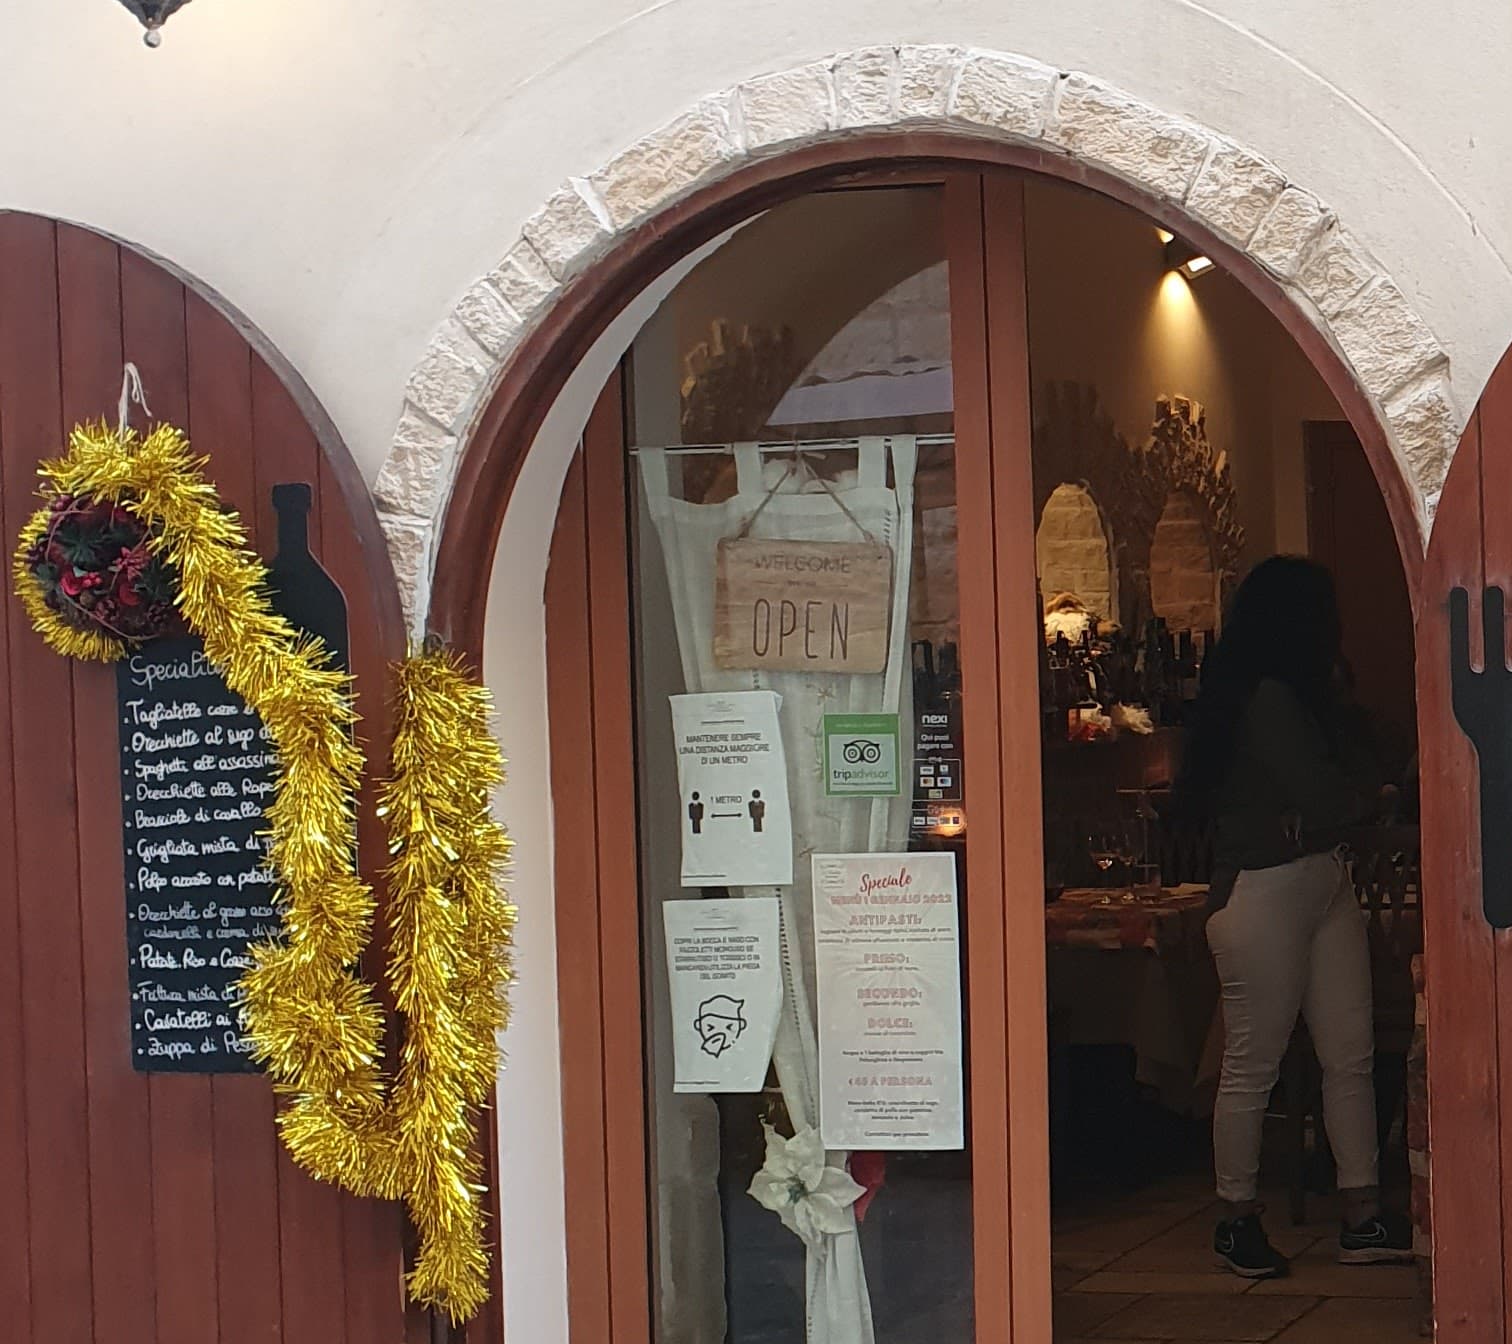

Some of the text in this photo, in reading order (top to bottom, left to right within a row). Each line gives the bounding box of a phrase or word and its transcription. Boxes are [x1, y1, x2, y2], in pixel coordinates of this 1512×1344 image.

[754, 555, 851, 574] WELCOME
[752, 598, 849, 661] OPEN
[126, 699, 201, 729] Tagliatelle
[922, 715, 948, 723] nexi
[132, 729, 199, 752] Orecchiette
[205, 726, 223, 745] al
[228, 727, 254, 750] sugo
[135, 757, 189, 781] Spaghetti
[722, 756, 748, 764] METRO
[137, 782, 206, 801] Orecchiette
[210, 782, 237, 797] alle
[716, 796, 742, 804] METRO
[195, 807, 210, 822] di
[137, 839, 198, 863] Grigliata
[202, 836, 240, 855] mista
[246, 834, 261, 850] di
[138, 867, 167, 892] Polpo
[860, 868, 912, 896] Speciale
[203, 902, 217, 919] al
[188, 985, 220, 1001] mista
[216, 1013, 231, 1026] ai
[149, 1037, 195, 1060] Zuppa
[200, 1036, 217, 1053] di
